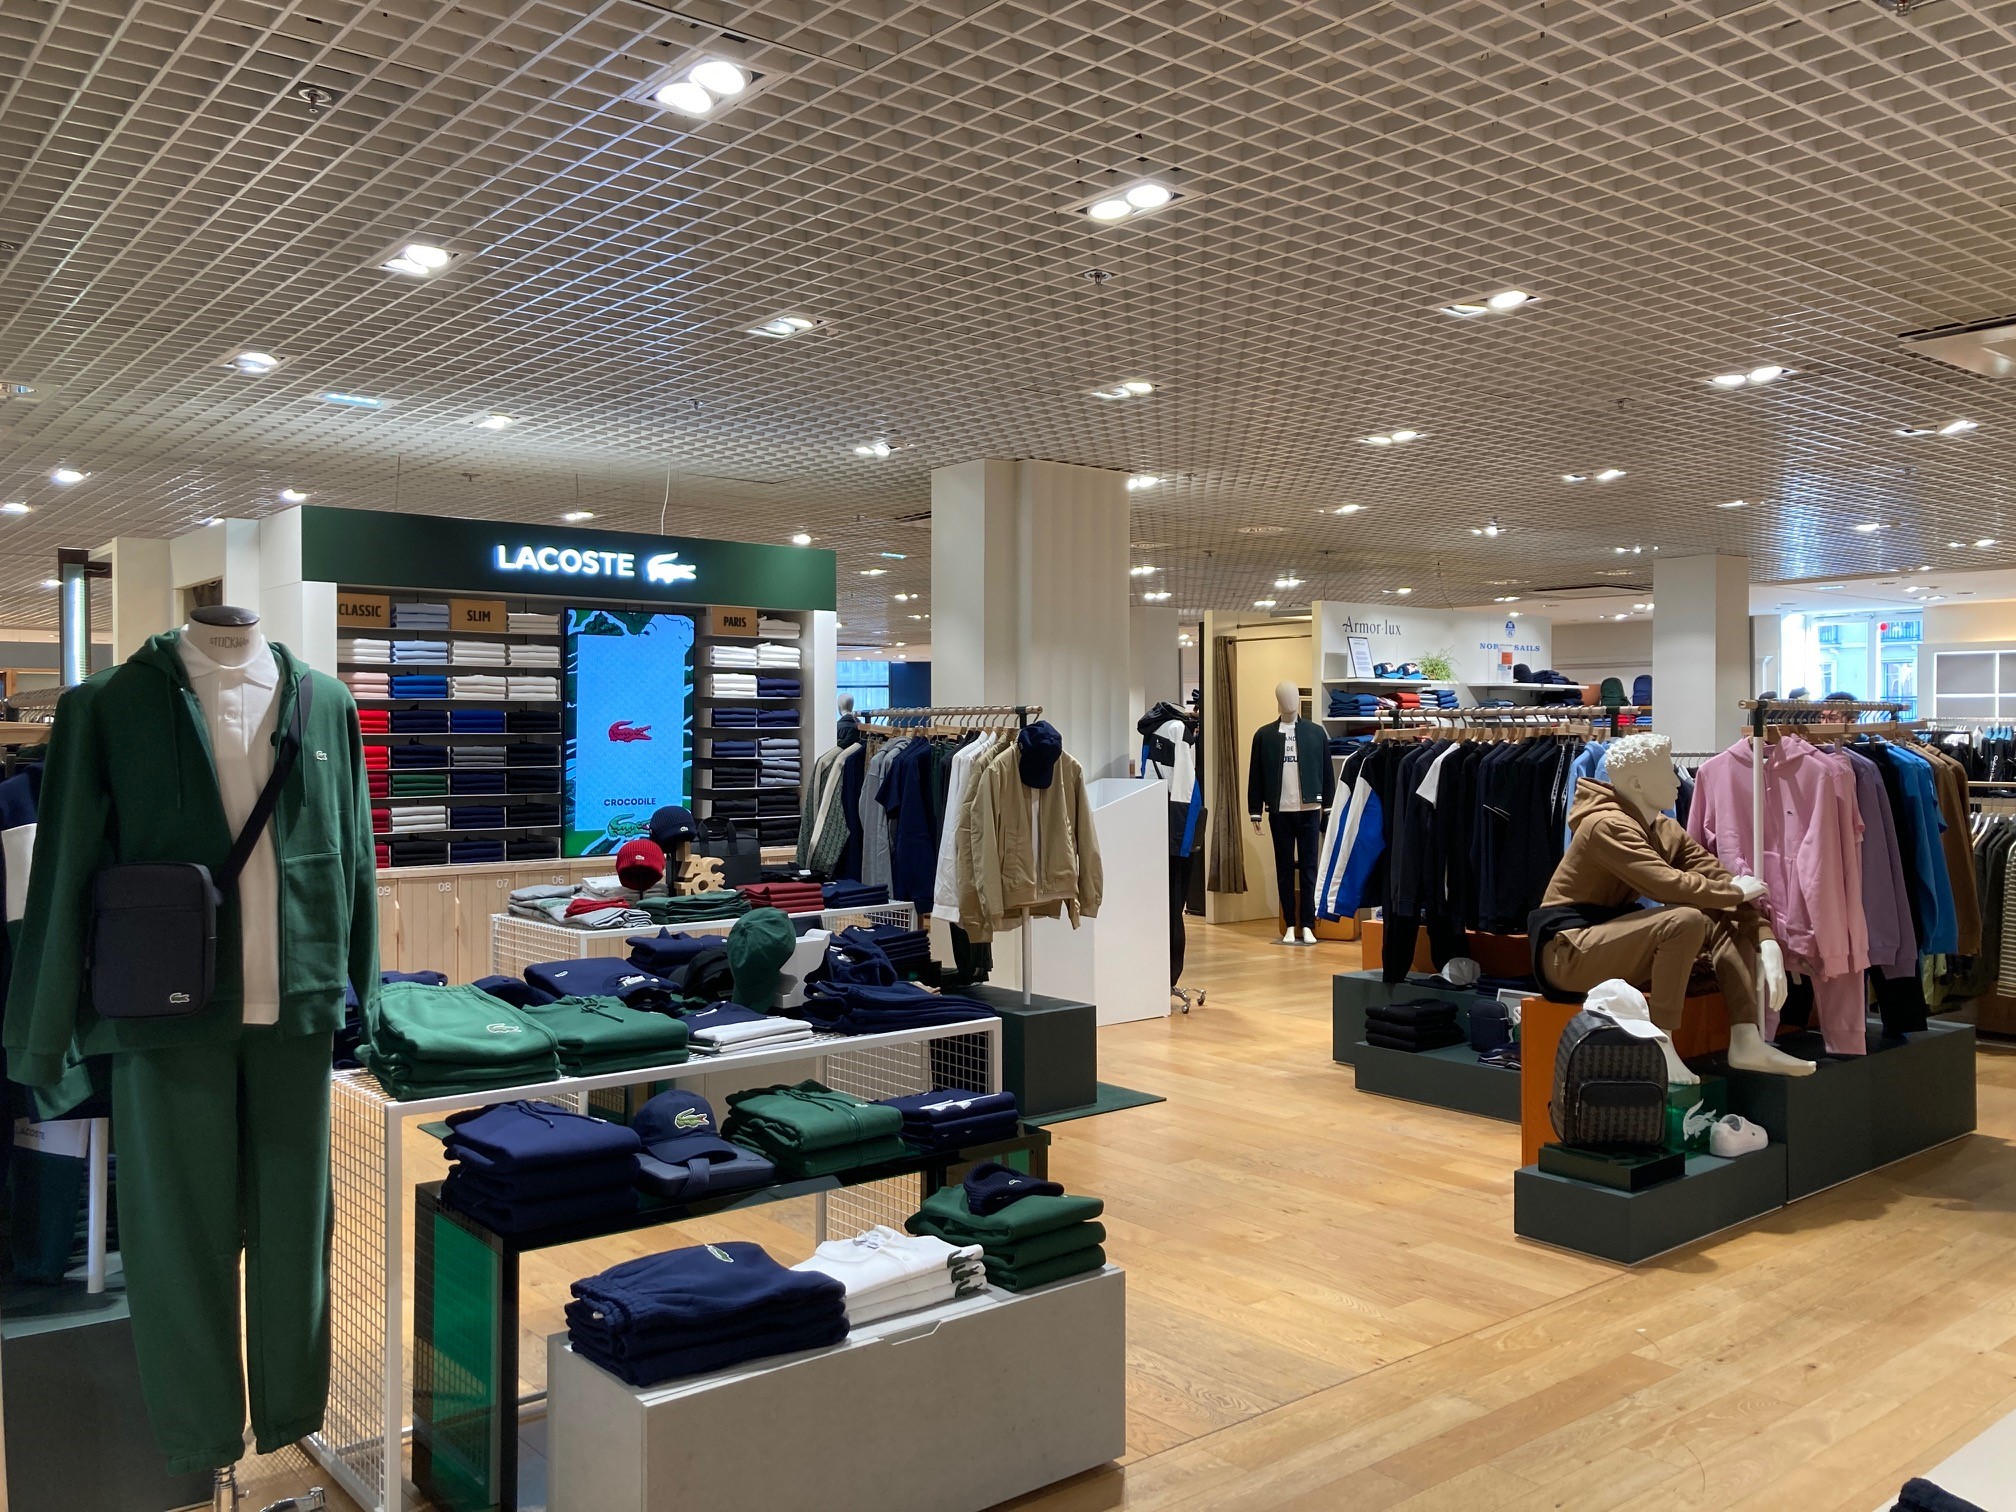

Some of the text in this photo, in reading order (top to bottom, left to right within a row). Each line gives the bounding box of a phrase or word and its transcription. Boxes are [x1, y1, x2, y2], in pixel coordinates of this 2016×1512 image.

[496, 544, 635, 577] LACOSTE
[338, 603, 382, 618] CLASSIC
[466, 609, 491, 622] SLIM
[723, 616, 747, 627] PARIS
[1479, 642, 1499, 650] NOR
[1513, 644, 1540, 652] SAILS
[604, 797, 656, 807] CROCODILE
[497, 878, 510, 888] 07
[552, 875, 565, 885] 06
[377, 886, 391, 896] 09
[438, 882, 452, 892] 08
